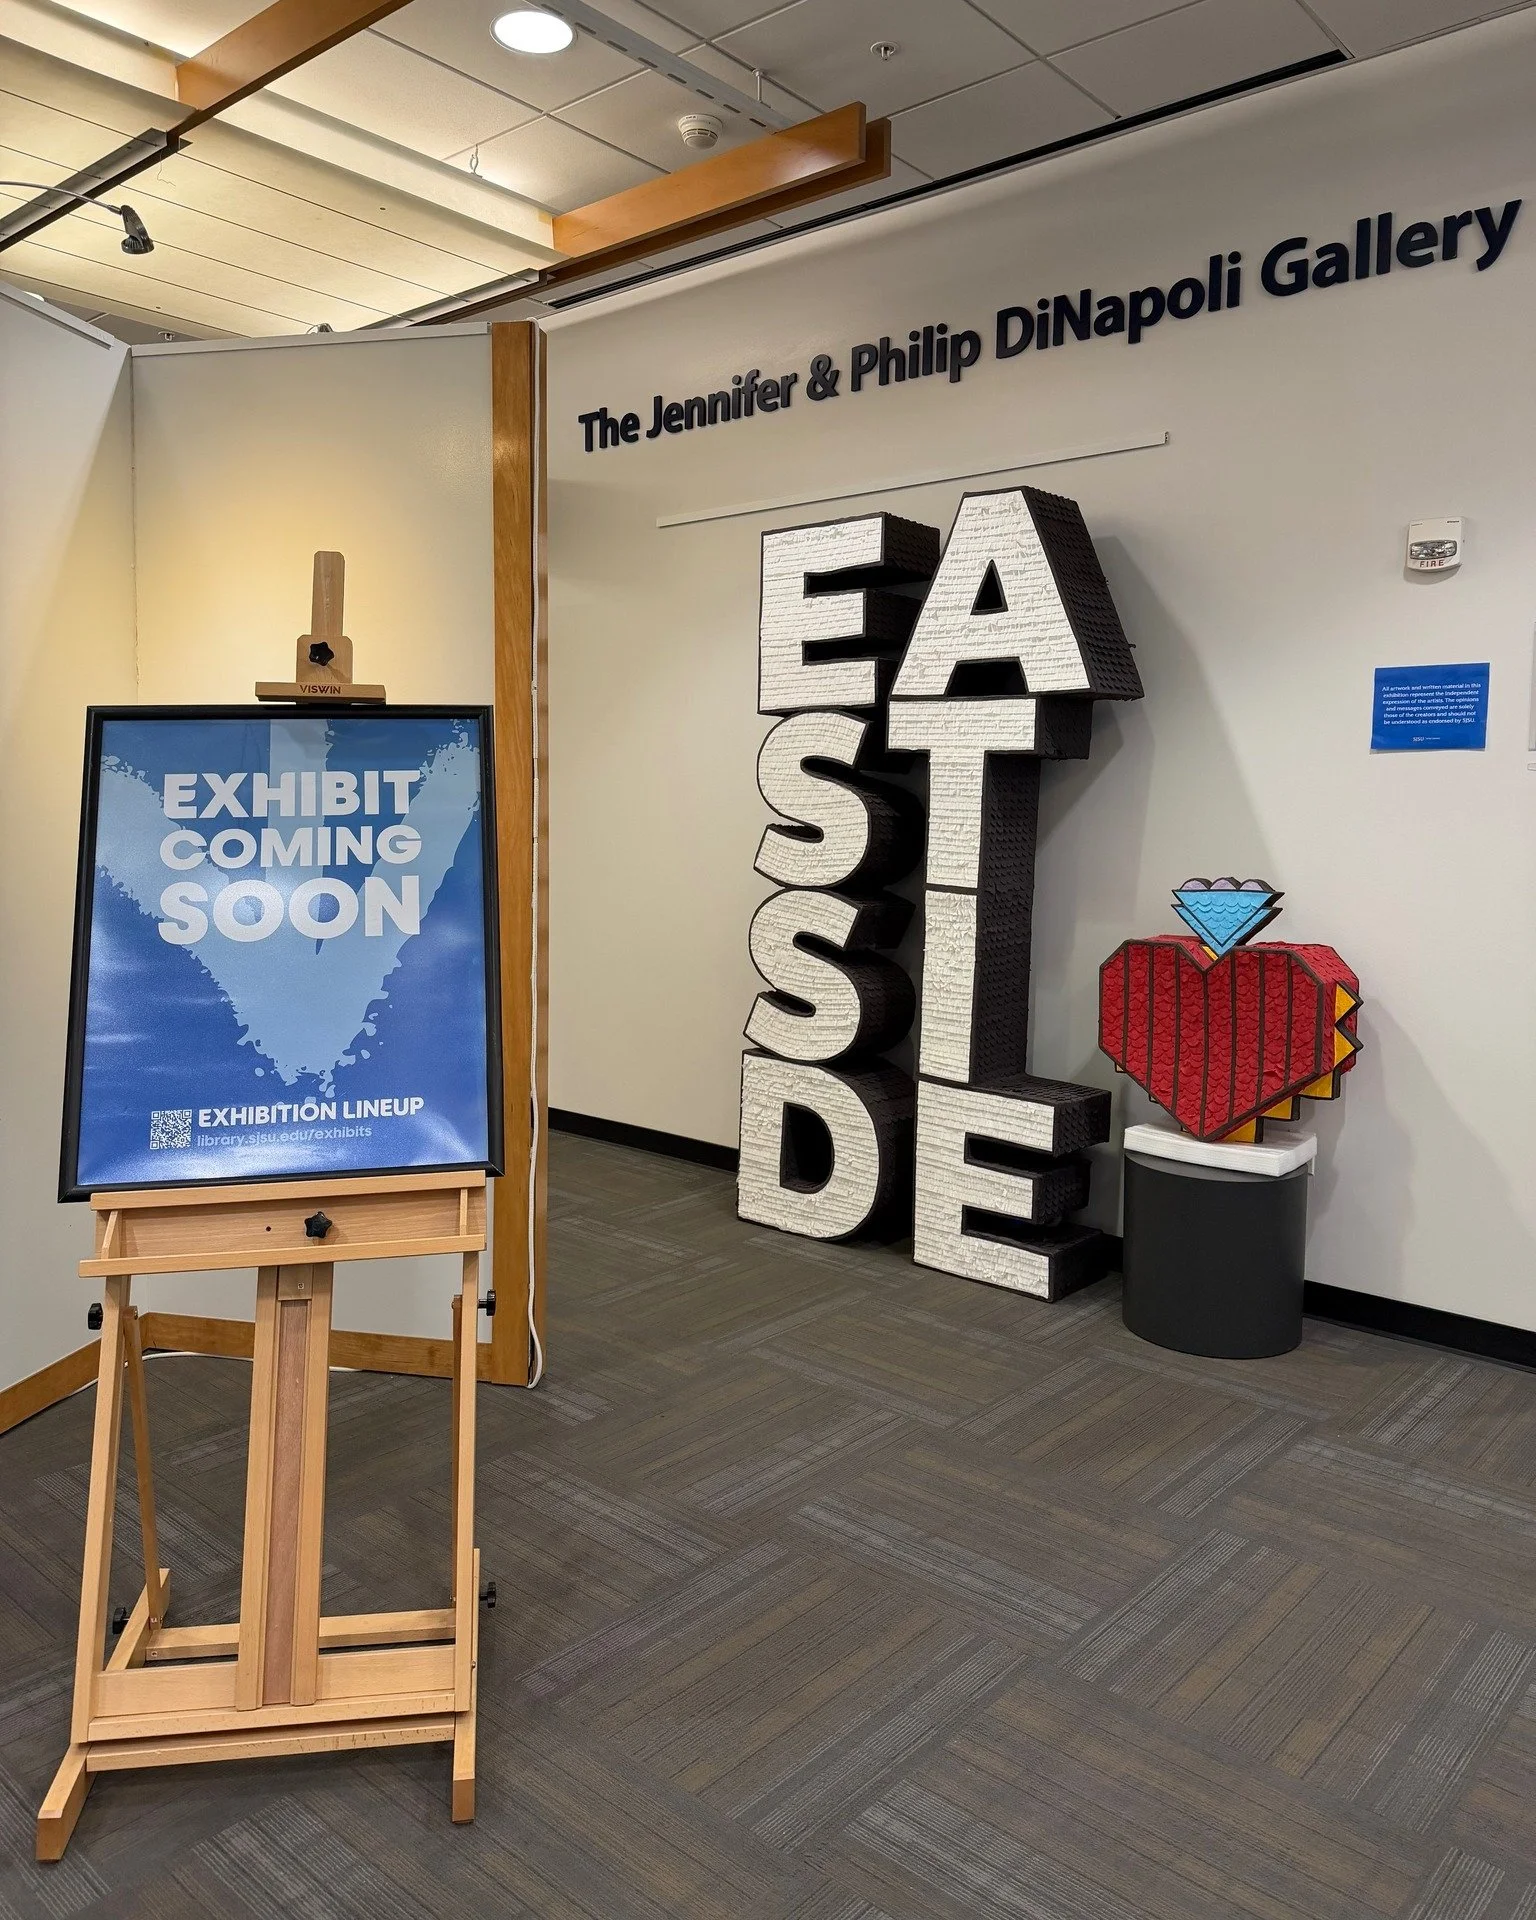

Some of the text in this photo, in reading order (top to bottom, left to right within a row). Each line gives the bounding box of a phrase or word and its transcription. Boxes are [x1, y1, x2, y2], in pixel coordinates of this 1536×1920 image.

[578, 198, 1523, 453] The Jennifer & Philip DiNapoli Gallery
[1419, 559, 1445, 567] FIRE
[300, 684, 341, 694] VISWIN
[162, 770, 421, 819] EXHIBIT
[159, 824, 422, 870] COMING
[157, 875, 421, 945] SOON
[198, 1096, 425, 1128] EXHIBITION LINEUP
[197, 1125, 372, 1148] library.sjsu.edu/exhibits
